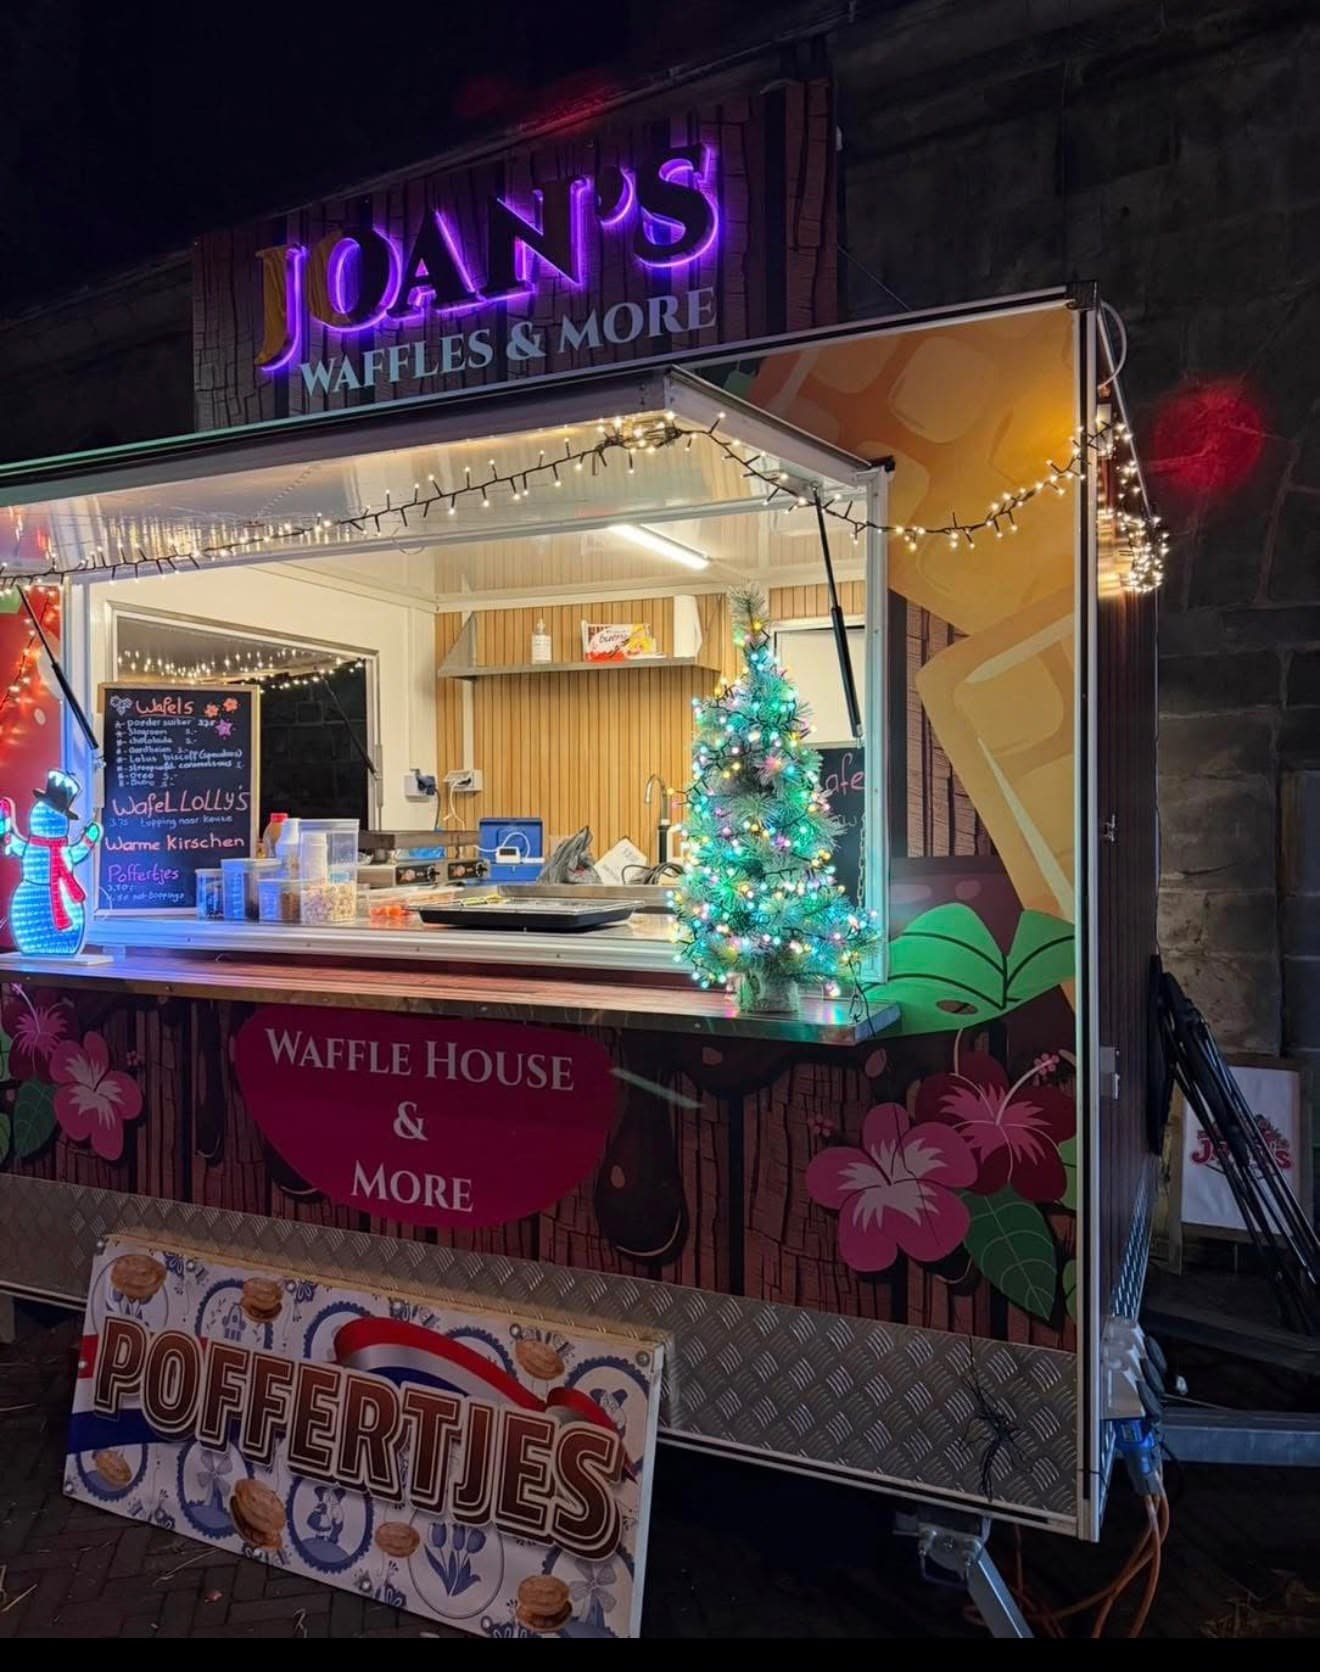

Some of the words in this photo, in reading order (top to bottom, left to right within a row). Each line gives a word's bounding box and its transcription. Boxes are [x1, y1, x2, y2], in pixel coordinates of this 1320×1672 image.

[256, 142, 720, 371] JOAN'S
[301, 328, 493, 397] WAFFLES
[506, 322, 546, 361] &
[558, 286, 718, 354] MORE
[105, 836, 161, 851] Warme
[166, 832, 245, 851] Kirschen
[108, 863, 179, 885] Poffertjes
[265, 1028, 412, 1076] WAFFLE
[424, 1040, 575, 1092] HOUSE
[393, 1101, 428, 1141] &
[350, 1160, 473, 1213] MORE
[94, 1316, 625, 1560] POFFERTJES
